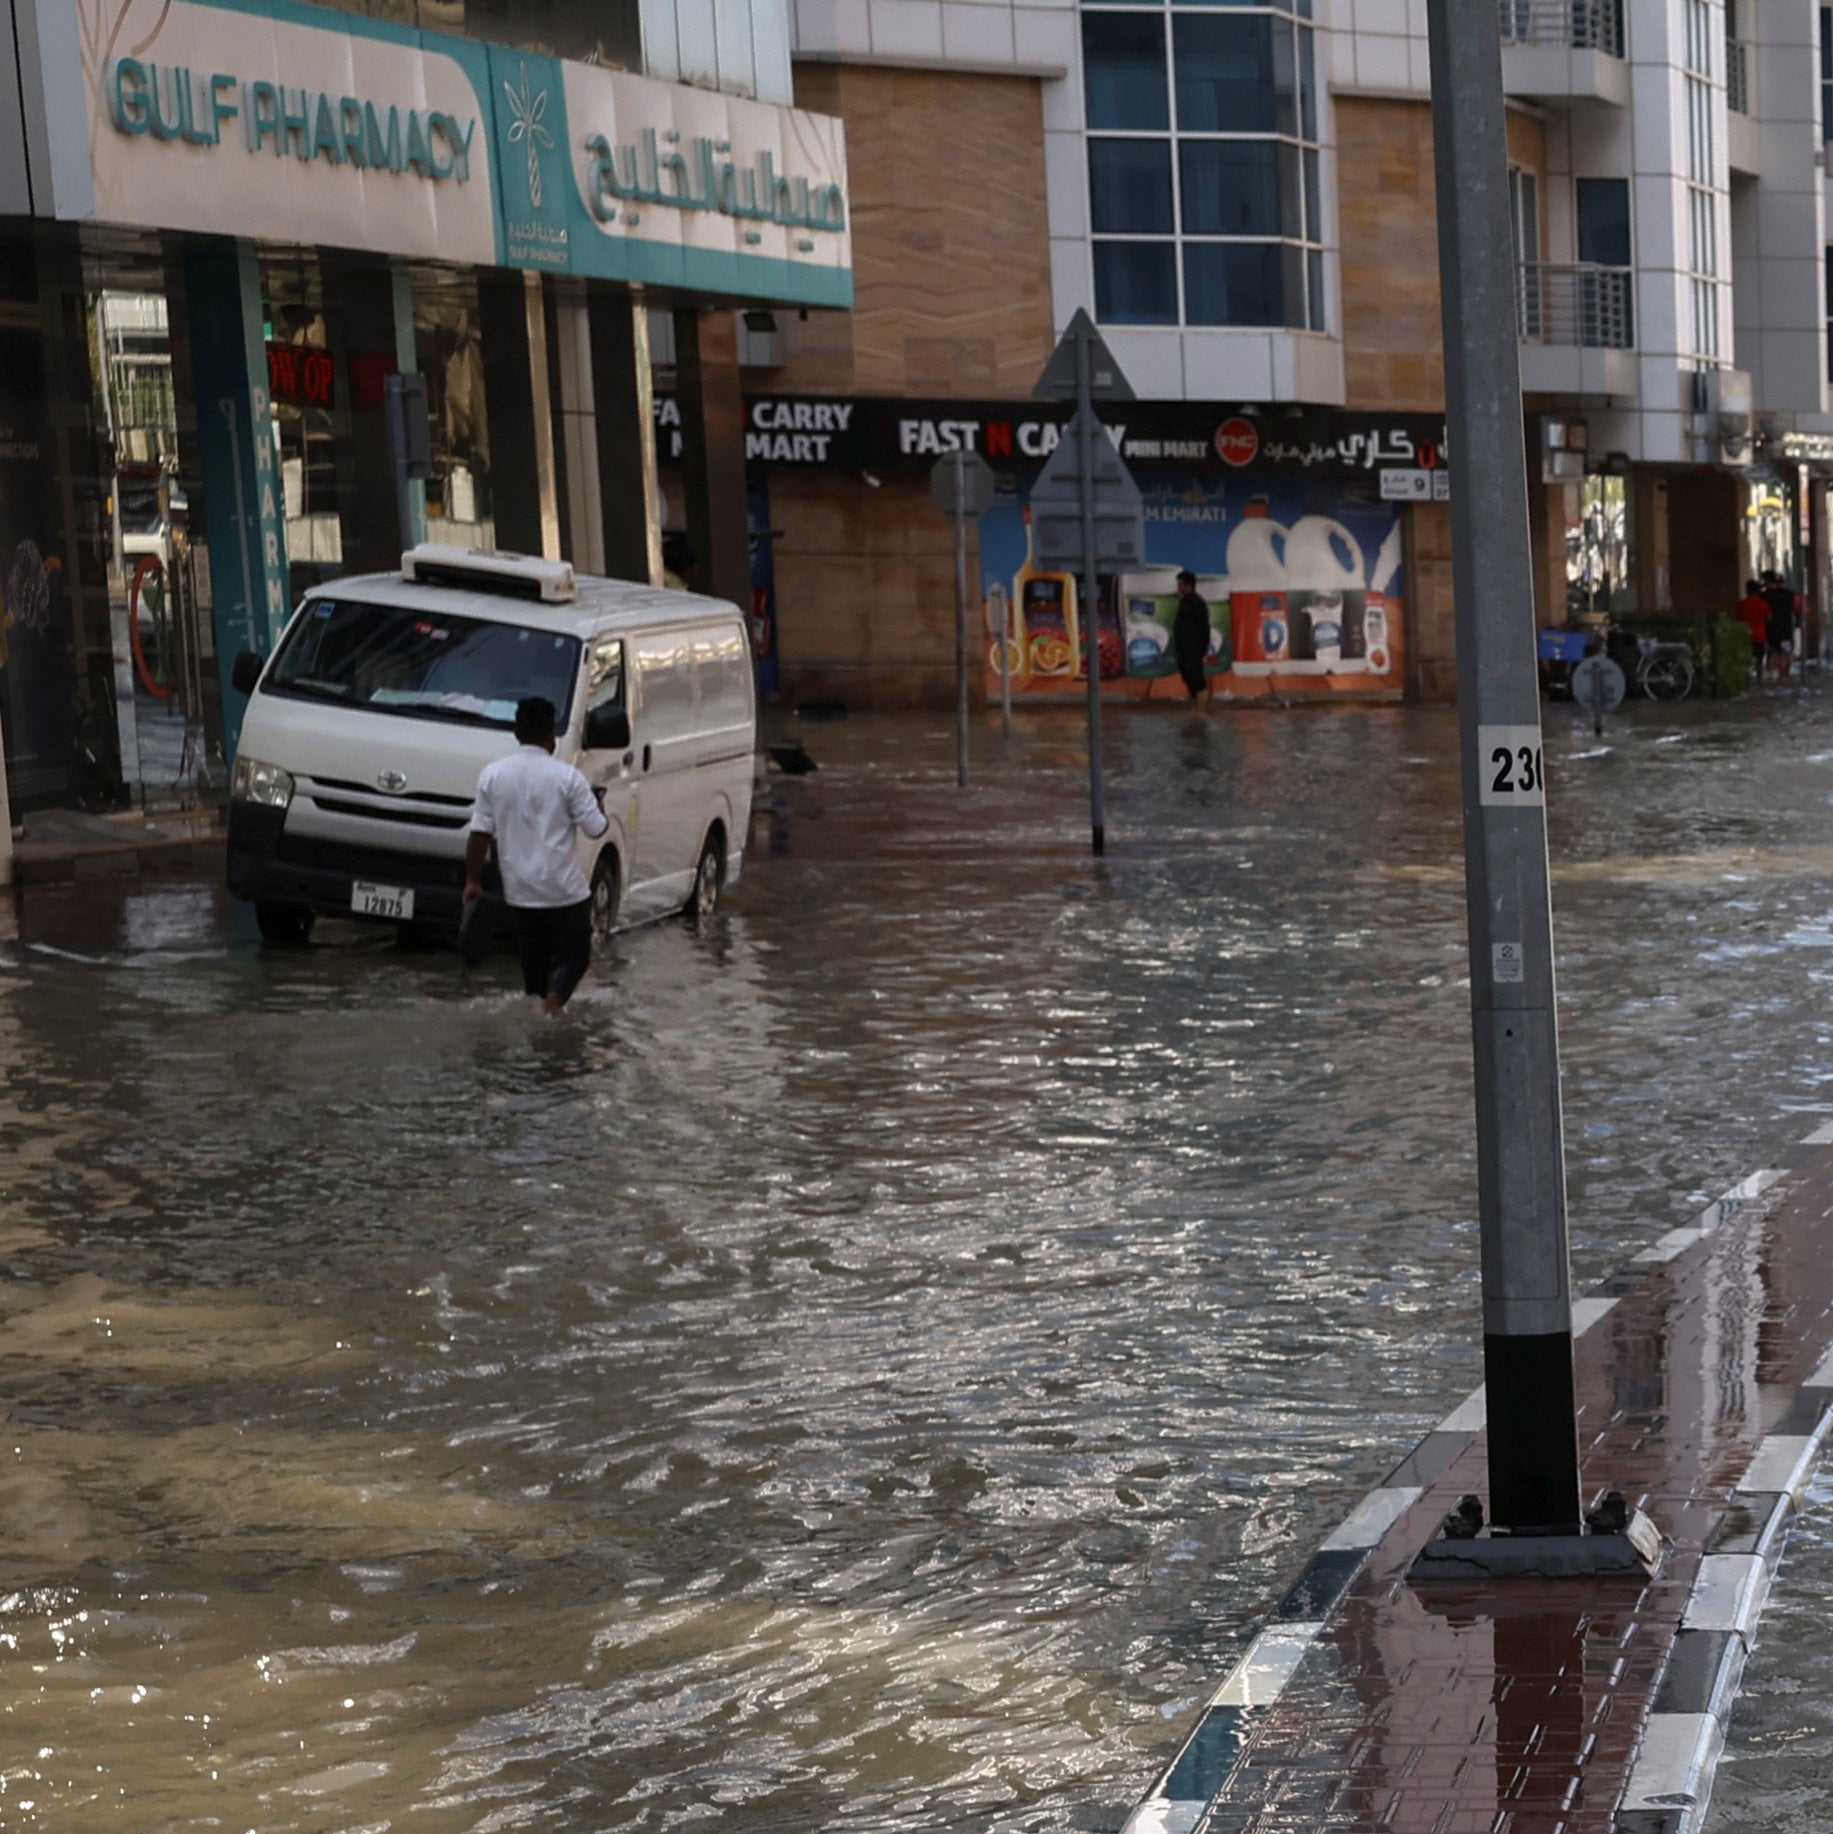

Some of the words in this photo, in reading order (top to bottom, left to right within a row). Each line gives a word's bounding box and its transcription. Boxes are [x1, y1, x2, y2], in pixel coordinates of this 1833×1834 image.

[105, 57, 238, 147] GULF
[246, 80, 475, 184] PHARMACY
[752, 402, 852, 432] CARRY
[745, 434, 830, 462] MART
[900, 420, 979, 455] FAST
[987, 421, 1011, 457] N
[1017, 421, 1127, 456] CAY
[1163, 440, 1207, 459] MART
[1327, 429, 1415, 470] كاري
[1414, 476, 1426, 492] 9
[1163, 507, 1226, 521] EMIRATI
